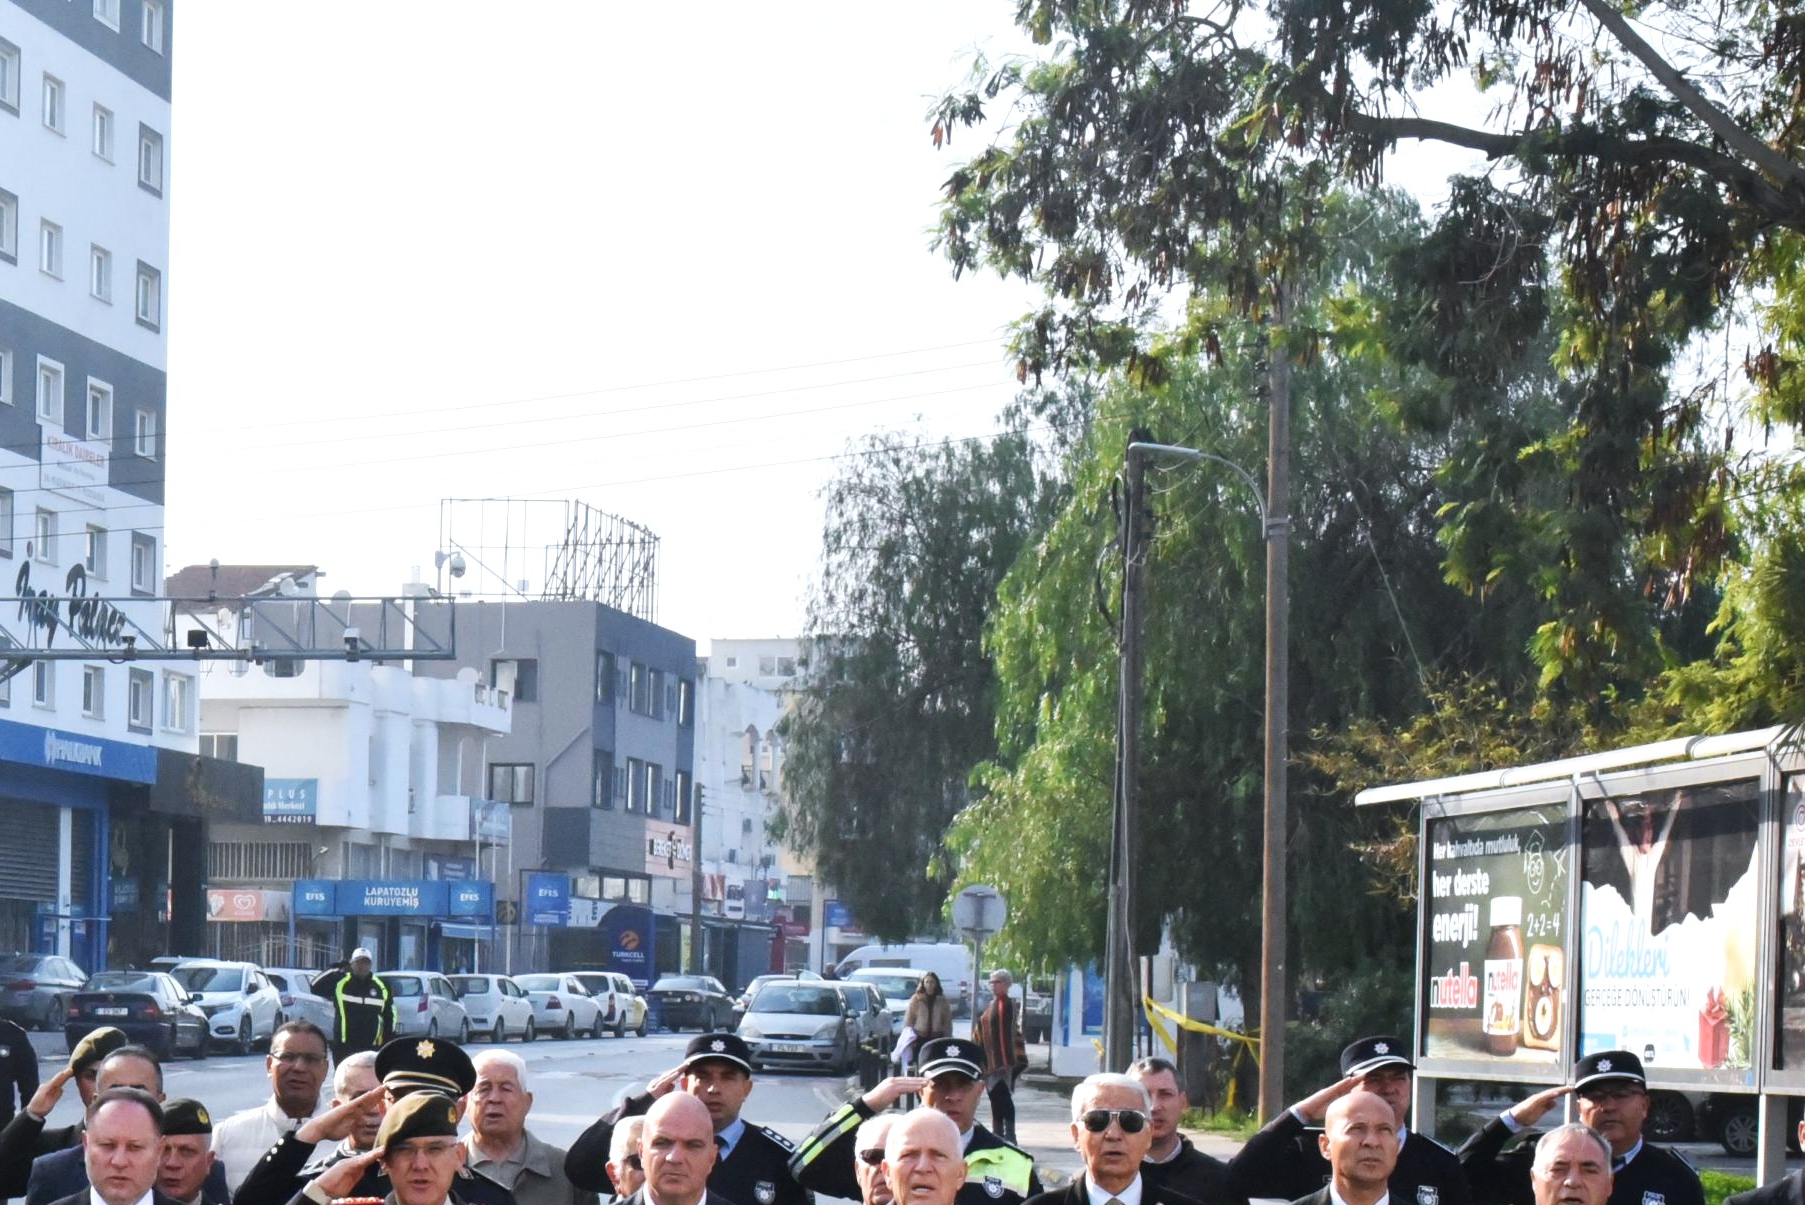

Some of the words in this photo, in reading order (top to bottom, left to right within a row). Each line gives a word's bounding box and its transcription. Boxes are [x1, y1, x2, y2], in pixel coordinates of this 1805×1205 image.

[1433, 841, 1447, 860] Her
[1447, 838, 1484, 858] kahvaltıda
[365, 887, 419, 897] LAPATOZLU
[1432, 870, 1452, 898] her
[1454, 868, 1490, 896] derste
[305, 892, 325, 901] EFES
[364, 896, 420, 909] KURUYEMİŞ
[460, 893, 479, 901] EFES
[1432, 903, 1479, 949] enerji!
[1588, 919, 1670, 979] Dilekleri
[1430, 961, 1478, 1009] nutella
[1488, 962, 1519, 992] nutella
